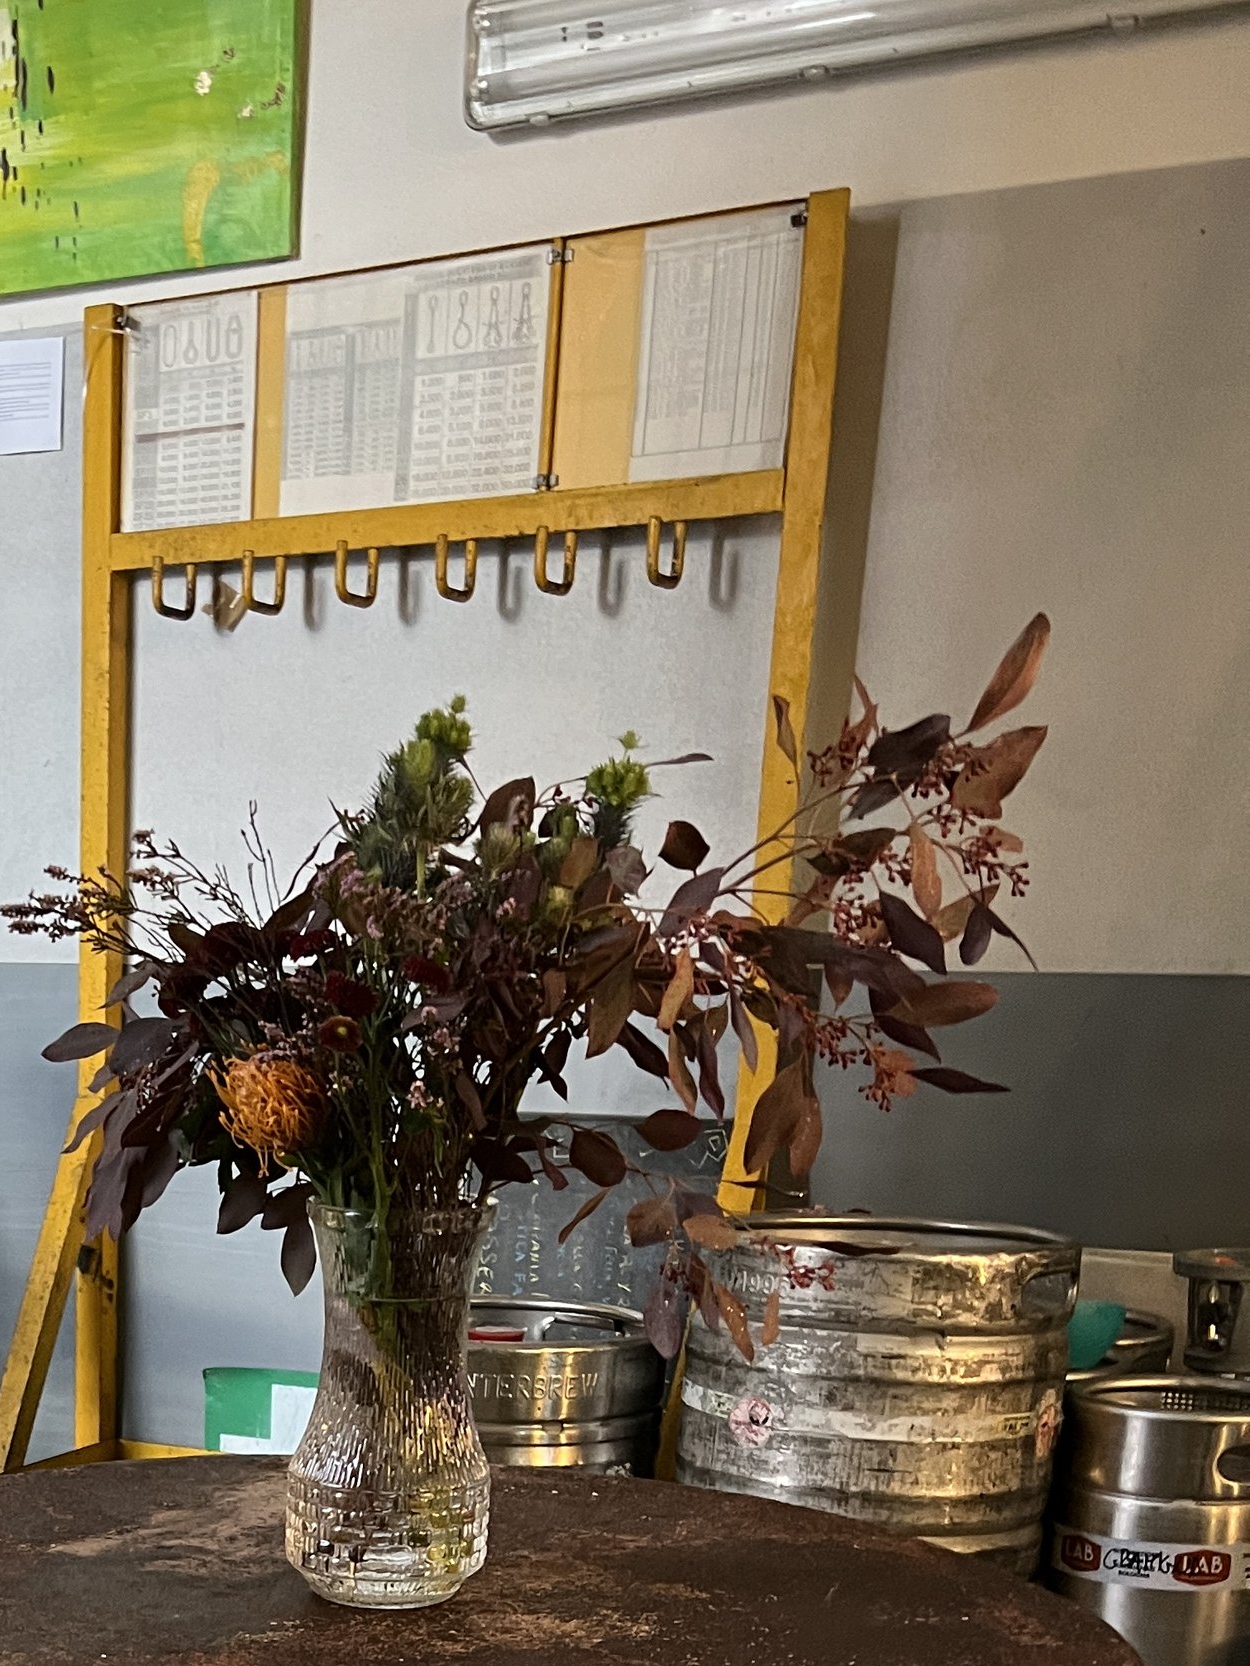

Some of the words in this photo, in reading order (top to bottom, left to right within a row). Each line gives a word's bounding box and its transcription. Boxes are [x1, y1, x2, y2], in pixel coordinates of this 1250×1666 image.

[466, 1373, 599, 1400] NTERBREW
[1065, 1537, 1095, 1562] LAB
[1182, 1555, 1224, 1575] LAB
